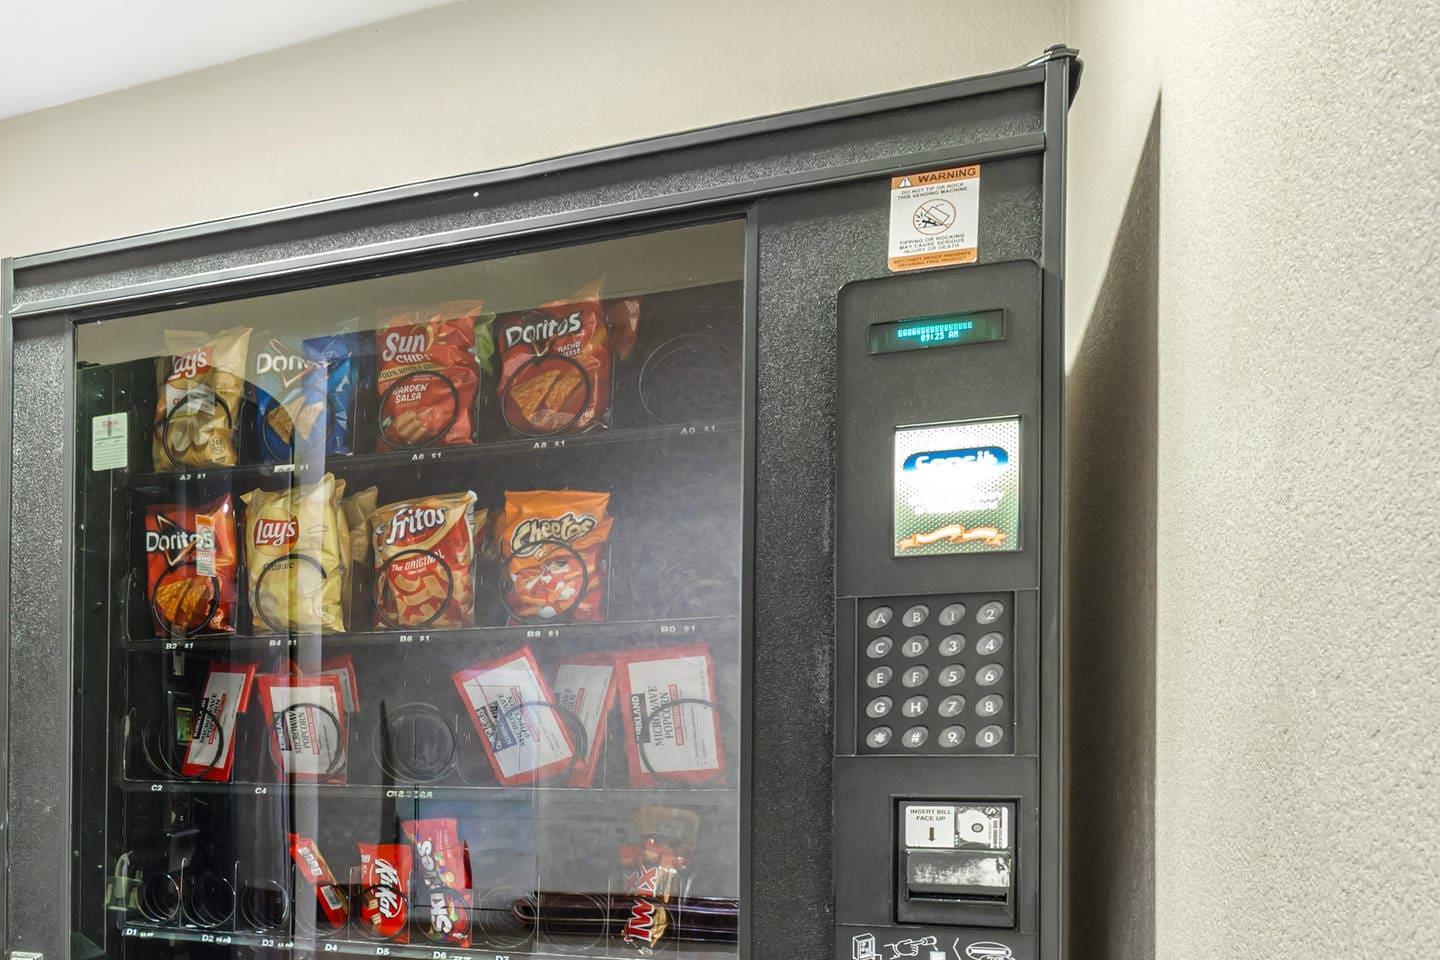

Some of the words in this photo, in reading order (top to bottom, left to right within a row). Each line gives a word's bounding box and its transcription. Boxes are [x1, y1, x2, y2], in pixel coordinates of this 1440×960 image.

[918, 167, 976, 183] WARNING
[940, 186, 968, 194] MACHINE
[505, 312, 581, 347] Doritos
[948, 330, 959, 338] AM
[382, 332, 425, 362] Sun
[563, 348, 582, 358] EESE
[392, 383, 429, 395] GARDEN
[395, 393, 422, 404] SALSA
[256, 519, 297, 546] Lay's
[512, 512, 598, 556] Cheetos
[146, 531, 213, 551] Doritos
[263, 561, 295, 572] Cassic
[404, 549, 446, 572] ORIGINAL
[874, 613, 886, 624] A
[912, 612, 922, 623] B
[986, 609, 995, 620] 2
[875, 642, 884, 654] C
[912, 642, 922, 653] D
[948, 640, 957, 652] 3
[985, 639, 995, 650] 4
[876, 673, 884, 683] E
[913, 672, 920, 683] F
[948, 671, 957, 682] 5
[985, 670, 994, 681] 6
[874, 702, 886, 713] G
[911, 702, 921, 712] H
[948, 701, 957, 712] 7
[985, 701, 994, 712] 8
[289, 703, 303, 756] MICROWAV
[984, 731, 994, 743] 0
[151, 784, 162, 792] C2
[255, 787, 267, 795] C4
[626, 864, 659, 943] TWIX
[262, 939, 274, 947] D3
[325, 944, 338, 952] D4
[376, 948, 390, 956] D5
[433, 951, 446, 959] D6
